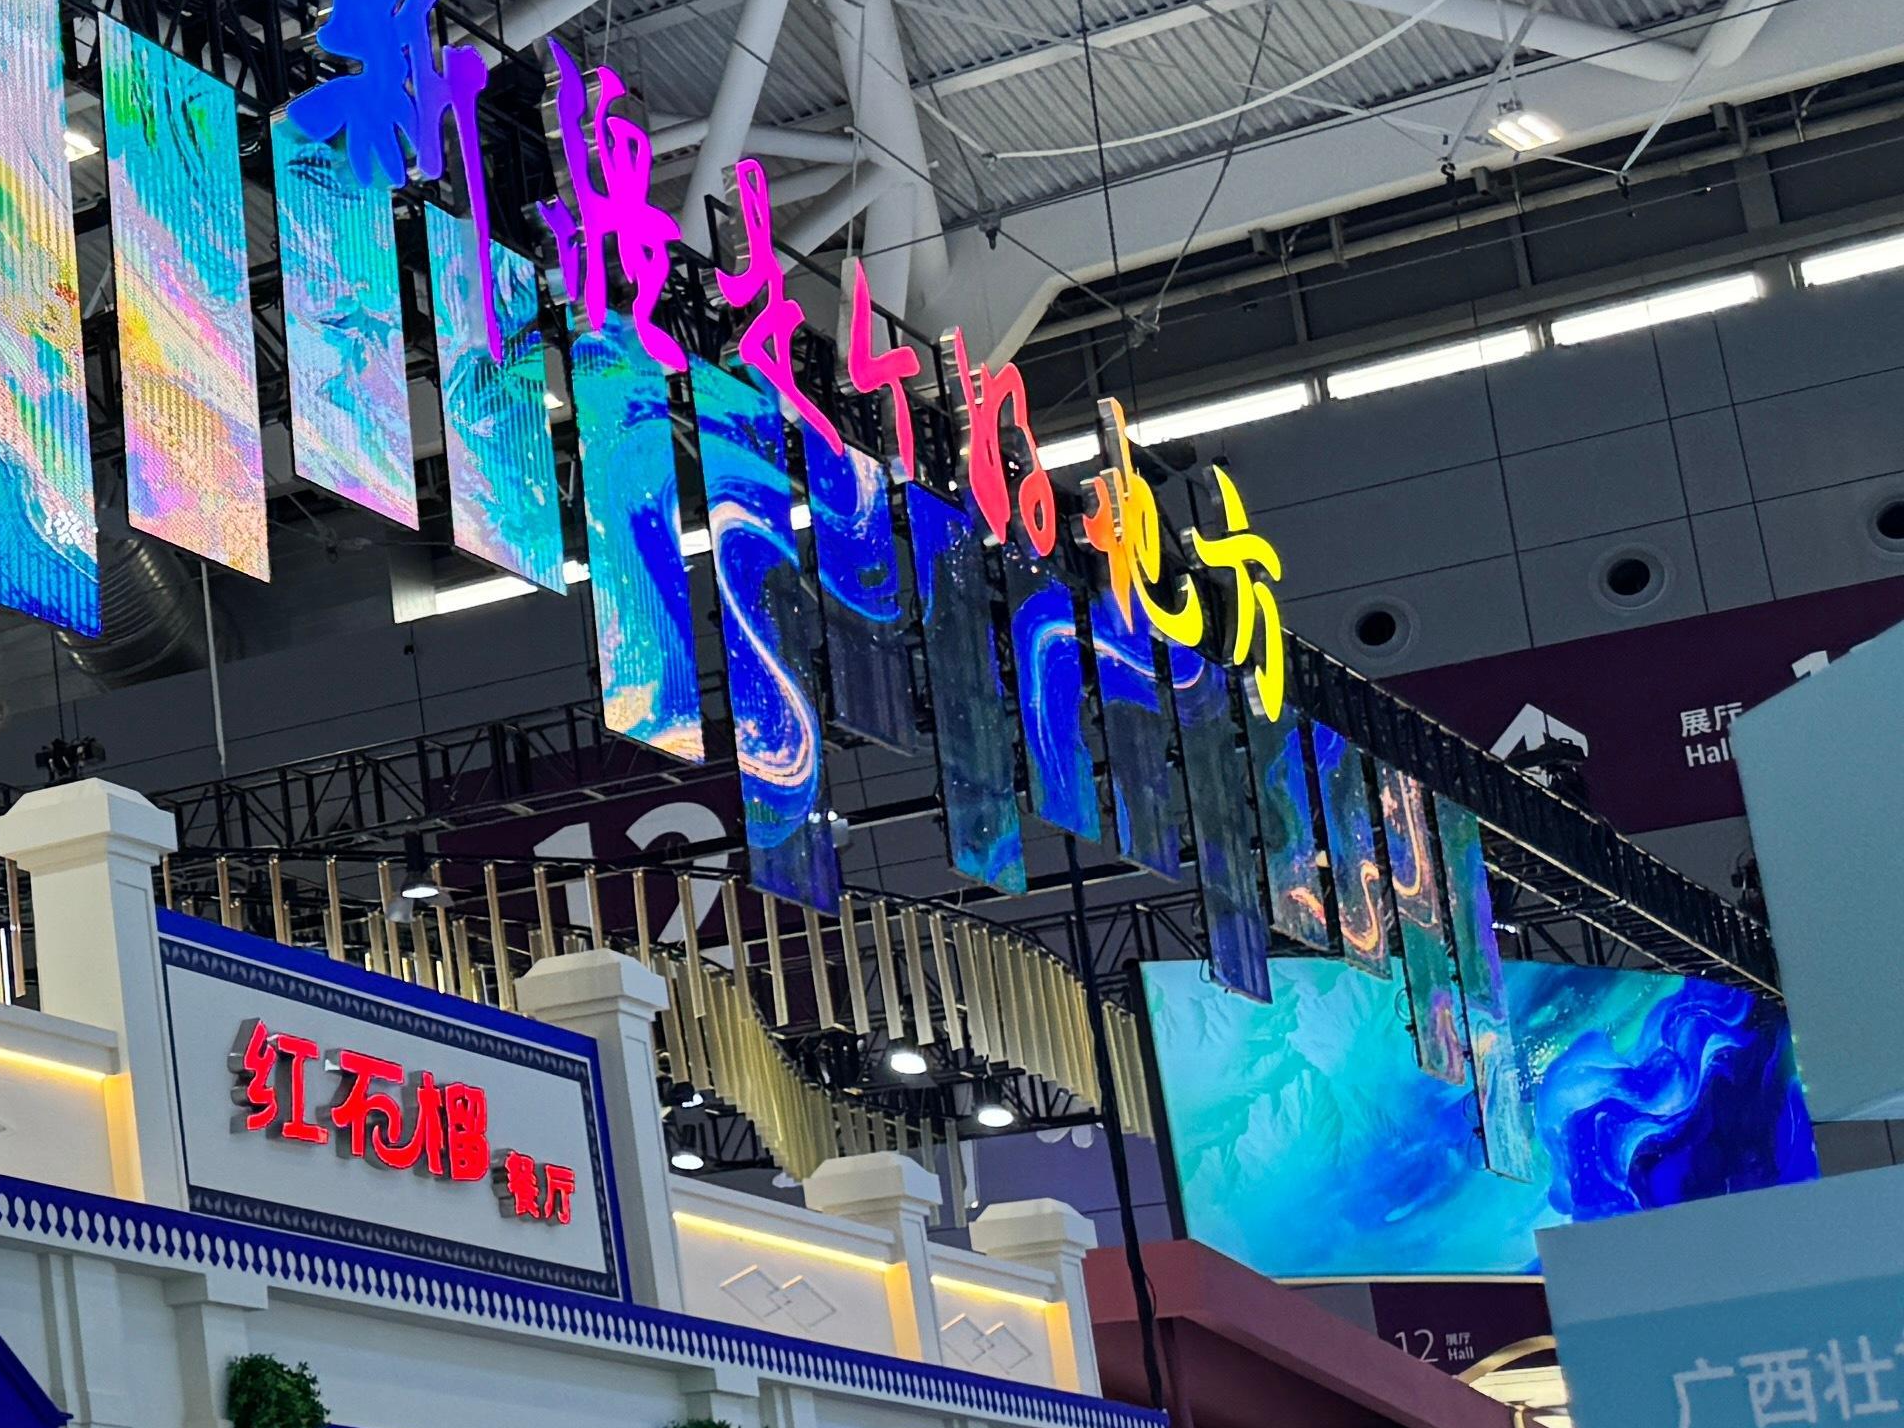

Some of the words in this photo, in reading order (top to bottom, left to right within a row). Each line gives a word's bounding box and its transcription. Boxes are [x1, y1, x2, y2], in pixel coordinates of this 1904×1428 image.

[1680, 701, 1743, 738] 展厅
[1685, 737, 1734, 768] Hal
[238, 1018, 490, 1183] 红石榴
[503, 1148, 576, 1225] 餐厅
[1447, 1346, 1475, 1362] Hall
